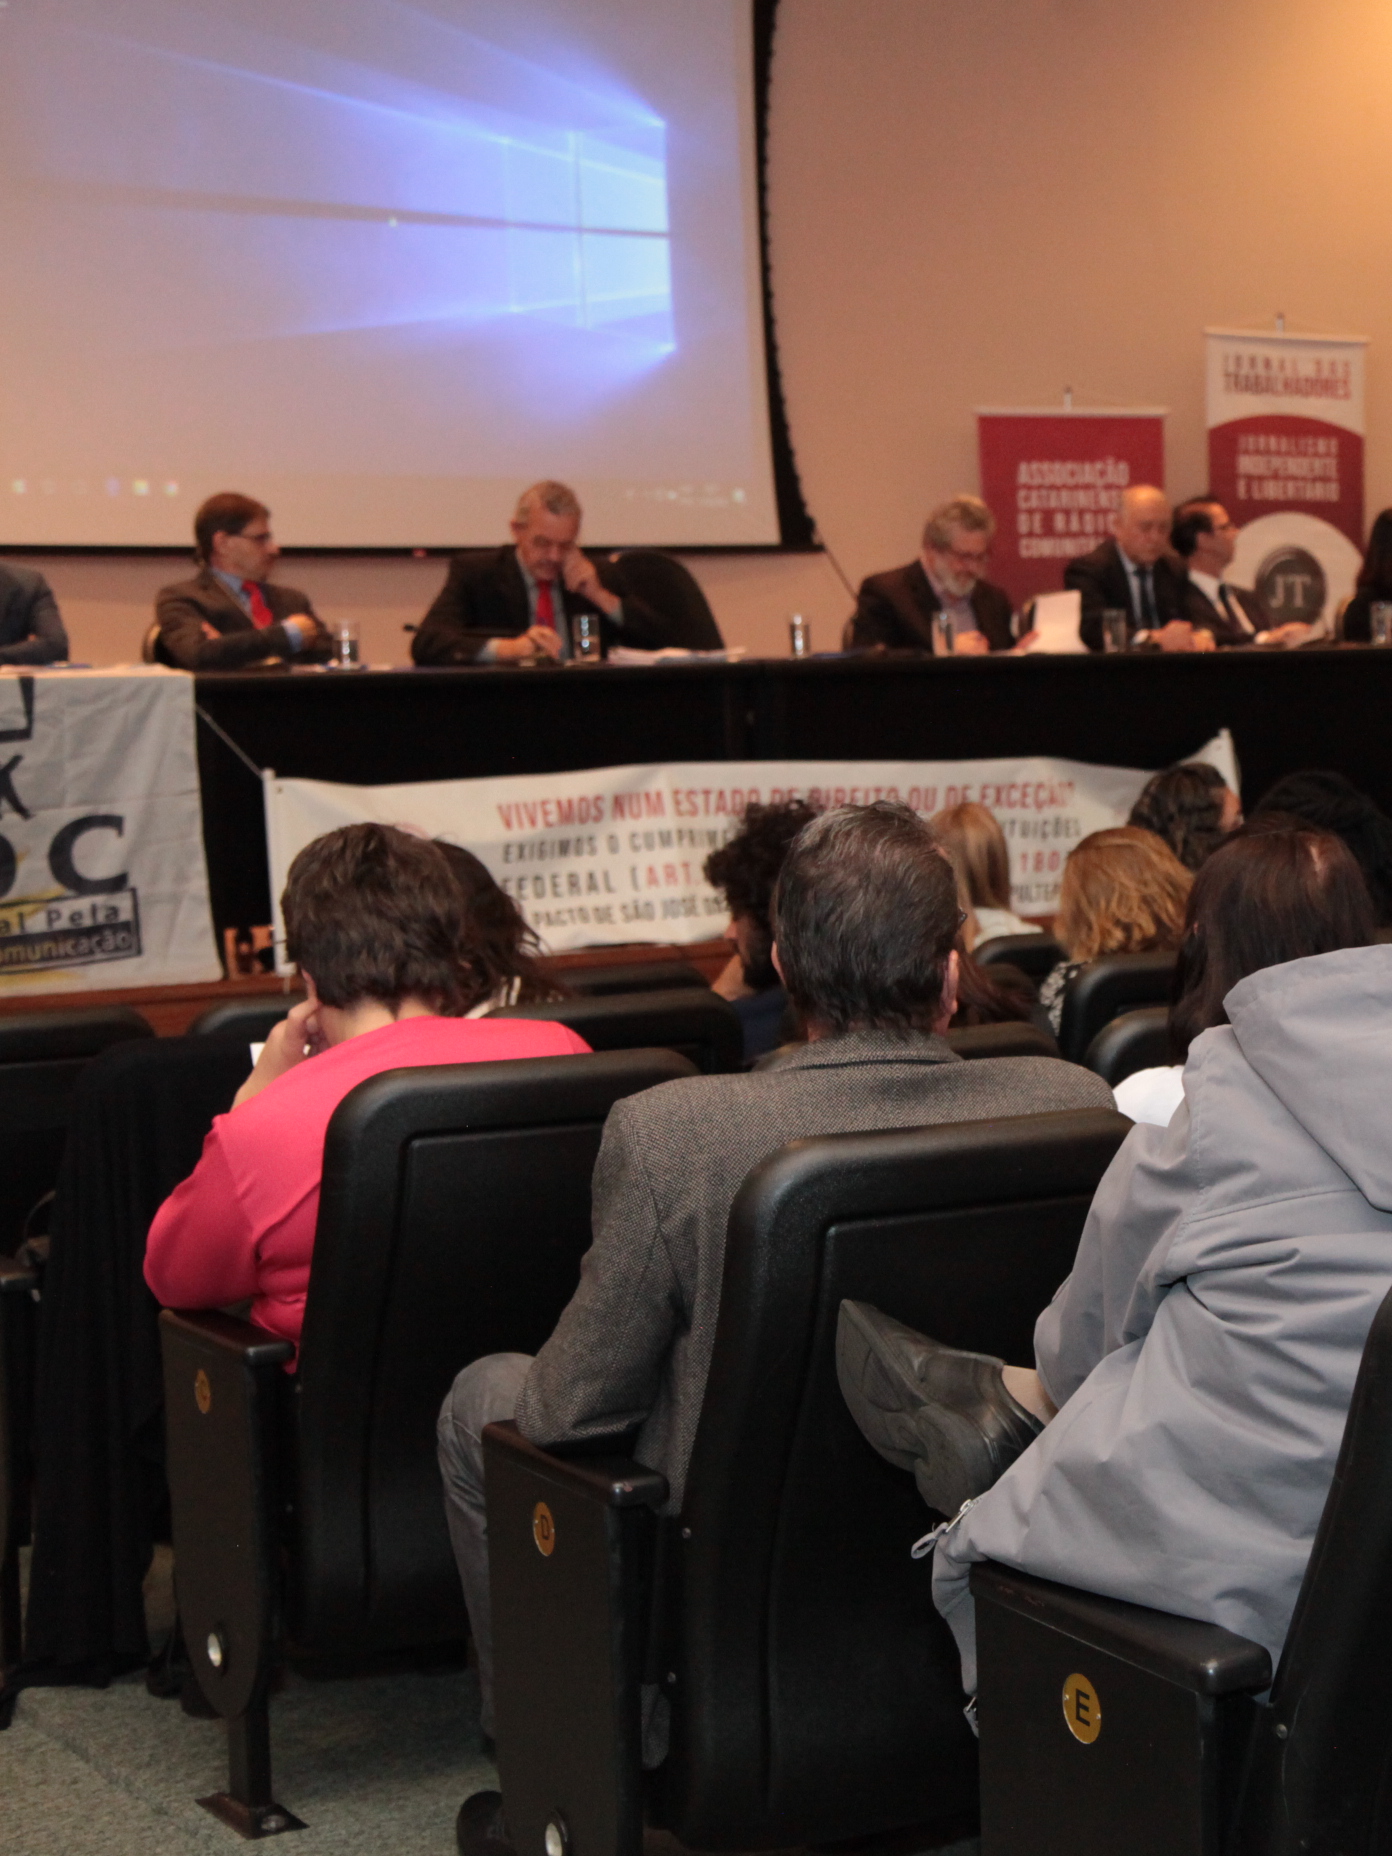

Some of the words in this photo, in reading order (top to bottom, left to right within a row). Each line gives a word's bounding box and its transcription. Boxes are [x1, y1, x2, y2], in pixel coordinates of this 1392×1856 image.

[1223, 370, 1353, 401] TRABALHADORES
[1017, 456, 1130, 489] ASSOCIAÇÃO
[1236, 454, 1339, 482] INDEPENDENTE
[1017, 510, 1043, 535] DE
[1269, 573, 1312, 609] JT
[497, 795, 605, 831] VIVEMOS
[612, 789, 667, 821] NUM
[908, 786, 937, 812] OU
[502, 834, 598, 864] EXIGIMOS
[606, 833, 621, 855] O
[501, 867, 616, 900] FEDERAL
[46, 903, 121, 930] Pela
[620, 898, 656, 924] SÃO
[0, 928, 133, 964] municação
[1075, 1687, 1091, 1728] E
